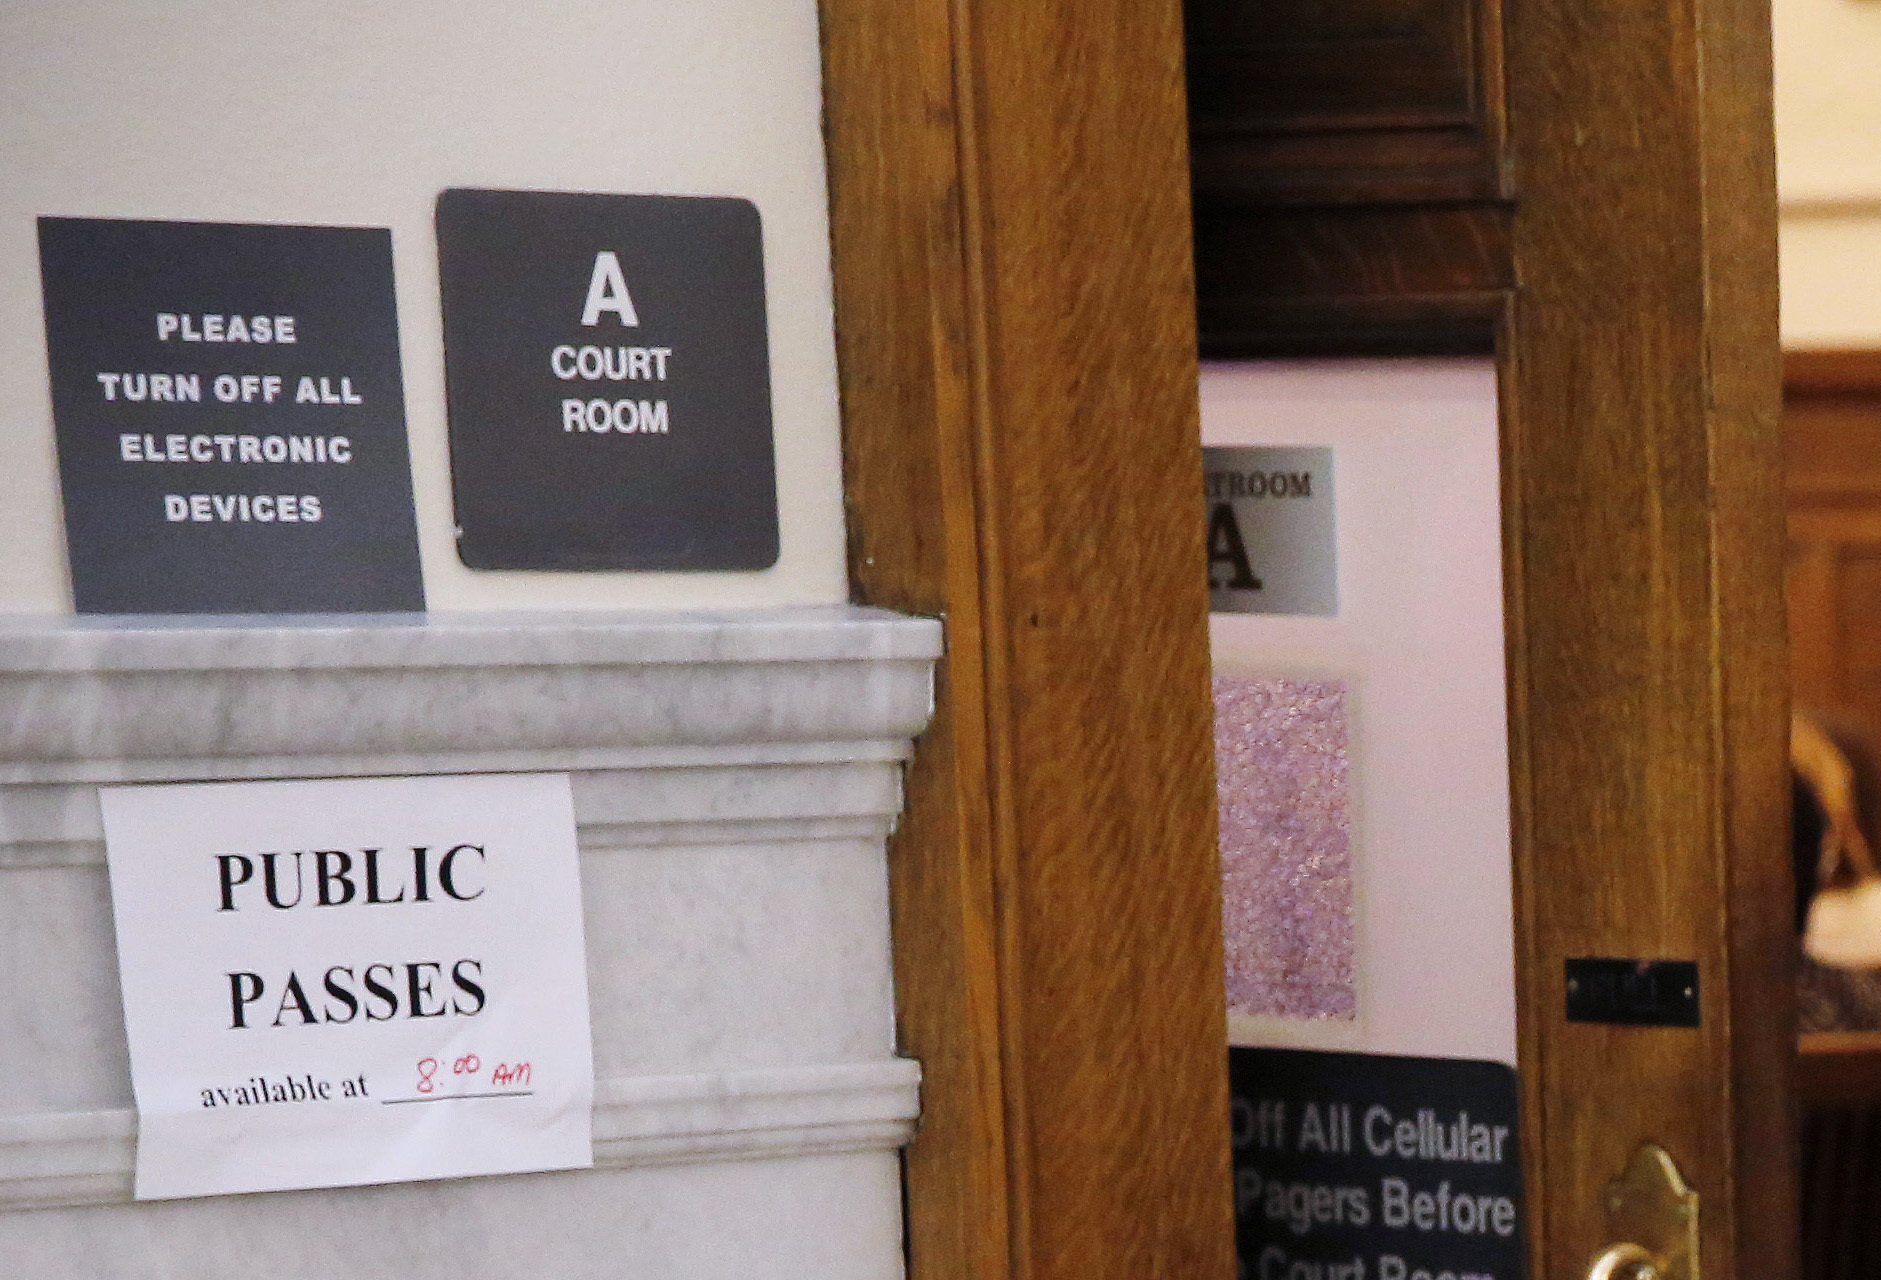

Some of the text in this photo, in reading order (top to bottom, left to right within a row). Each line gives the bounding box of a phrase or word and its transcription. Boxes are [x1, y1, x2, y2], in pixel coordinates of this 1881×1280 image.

[581, 252, 639, 327] A
[156, 313, 297, 345] PLEASE
[551, 346, 672, 381] COURT
[98, 373, 362, 405] TURN OFF ALL
[563, 400, 669, 434] ROOM
[121, 435, 351, 464] ELECTRONIC
[164, 494, 322, 522] DEVICES
[1208, 504, 1263, 590] A
[215, 844, 486, 912] PUBLIC
[225, 960, 486, 1029] PASSES
[201, 1075, 330, 1110] available
[342, 1074, 369, 1099] at
[1302, 1103, 1350, 1152] All
[1364, 1105, 1509, 1163] Cellular
[1237, 1167, 1516, 1237] Pagers Before
